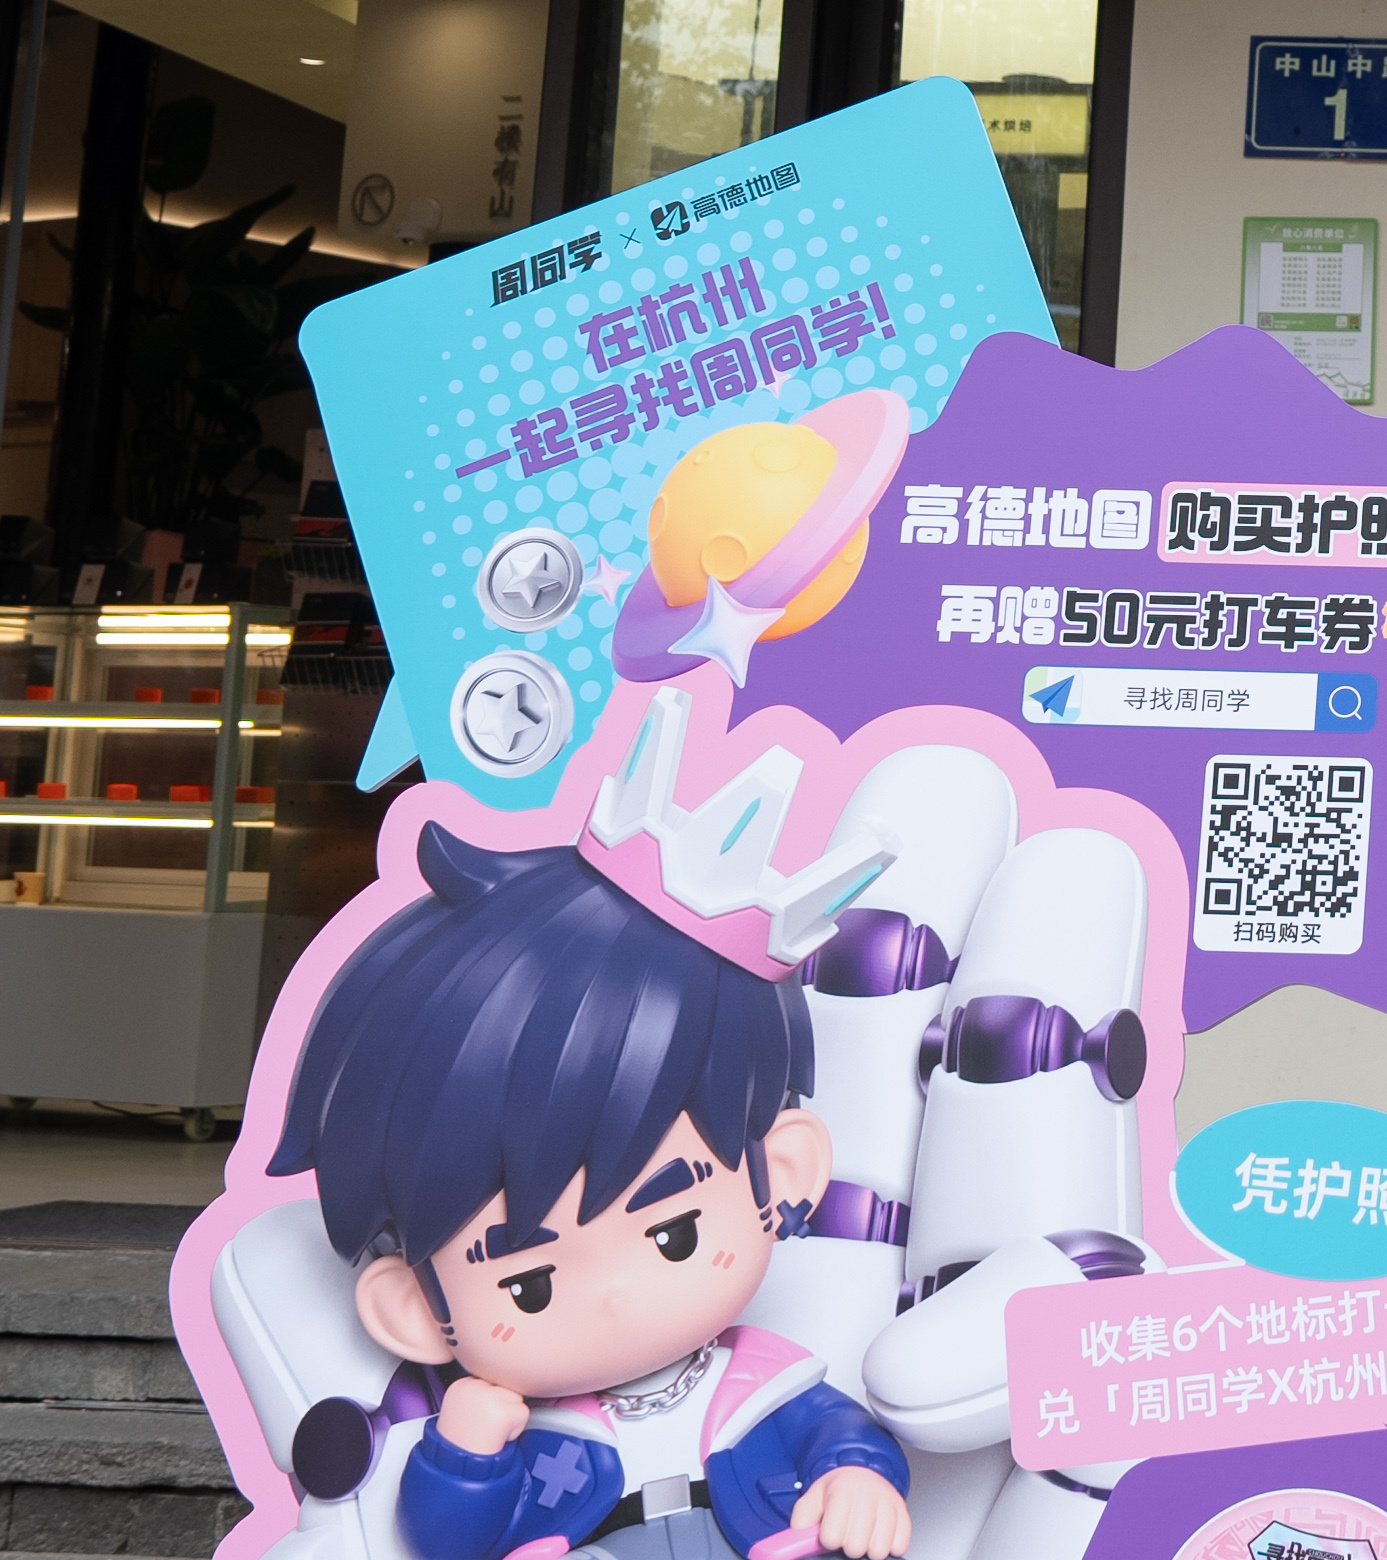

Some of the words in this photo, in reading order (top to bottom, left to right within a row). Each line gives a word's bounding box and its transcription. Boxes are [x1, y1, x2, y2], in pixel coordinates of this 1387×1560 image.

[1323, 88, 1348, 142] 1
[489, 230, 603, 309] 周同学
[690, 161, 801, 223] 高德地图
[578, 255, 767, 374] 在杭州
[900, 484, 1153, 550] 高德地图
[936, 583, 1379, 654] 再赠50元打车券
[1123, 686, 1251, 716] 寻找周同学
[1233, 920, 1323, 946] 扫码购买
